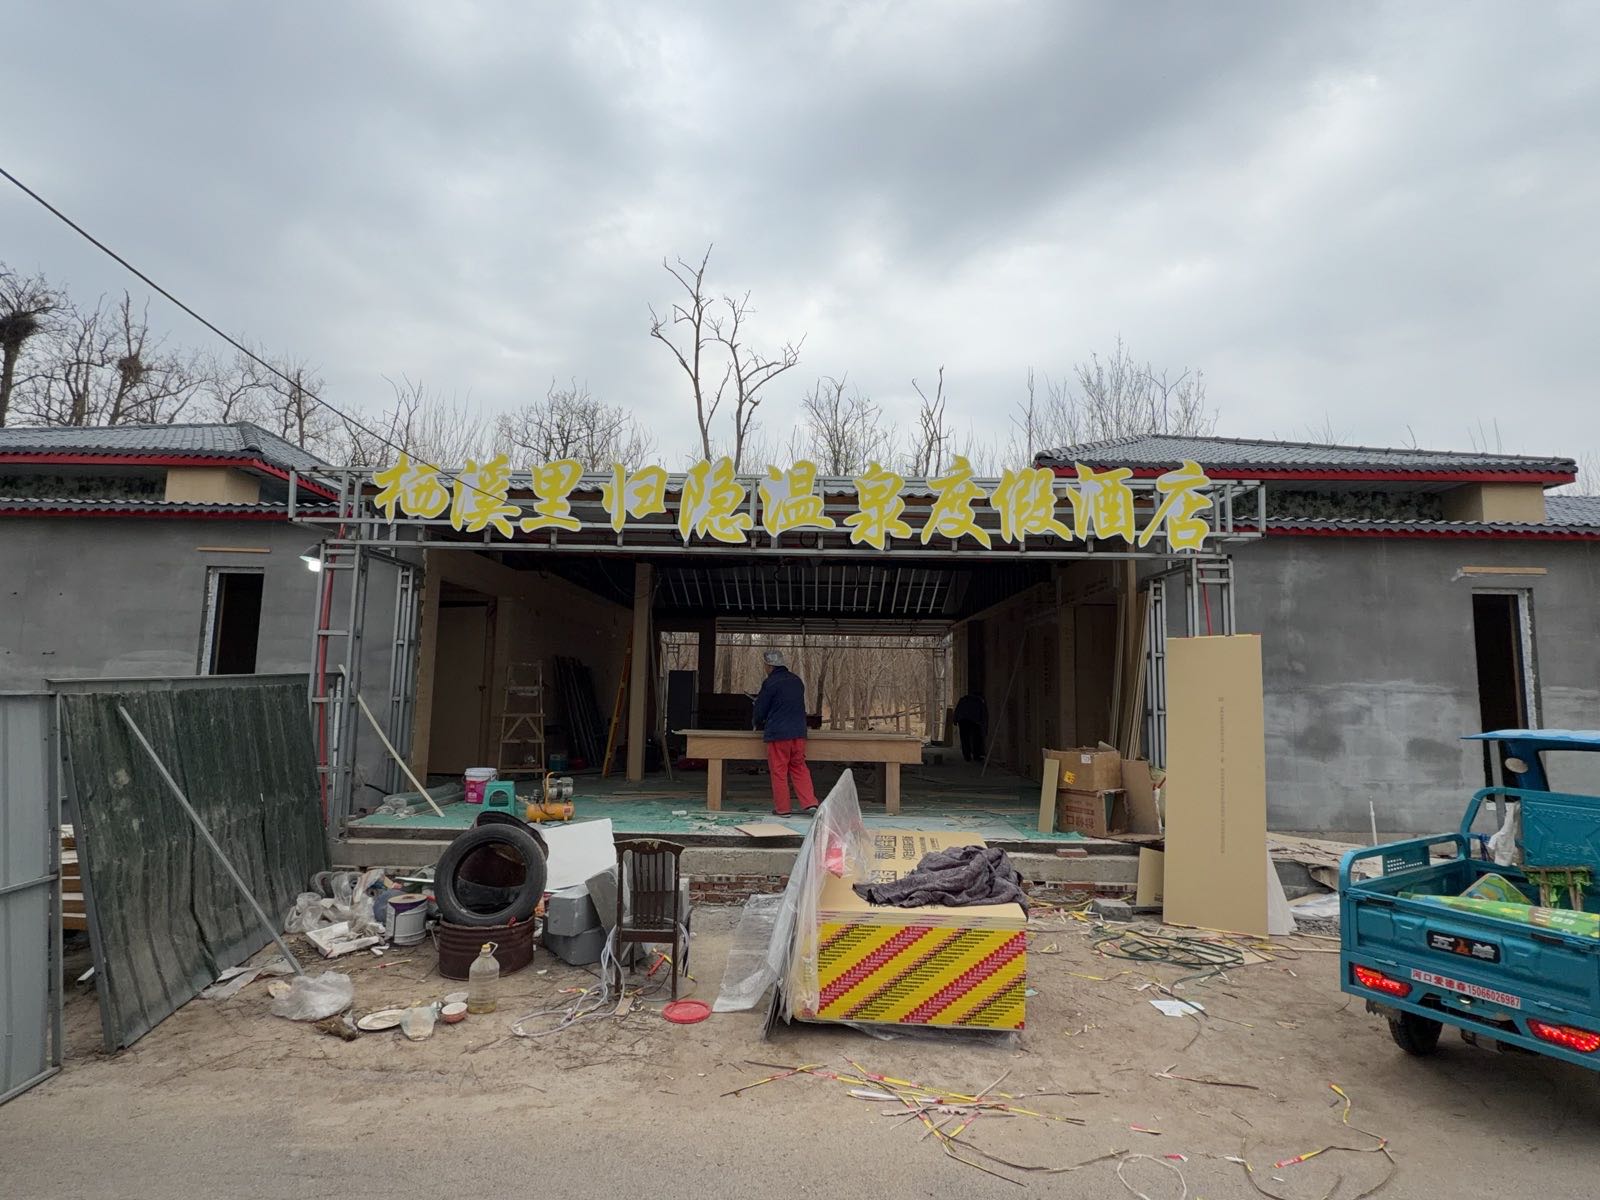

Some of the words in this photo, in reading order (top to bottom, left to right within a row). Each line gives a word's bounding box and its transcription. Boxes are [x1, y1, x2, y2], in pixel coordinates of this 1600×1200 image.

[371, 453, 1213, 552] 栖溪里归隐温泉度假酒店
